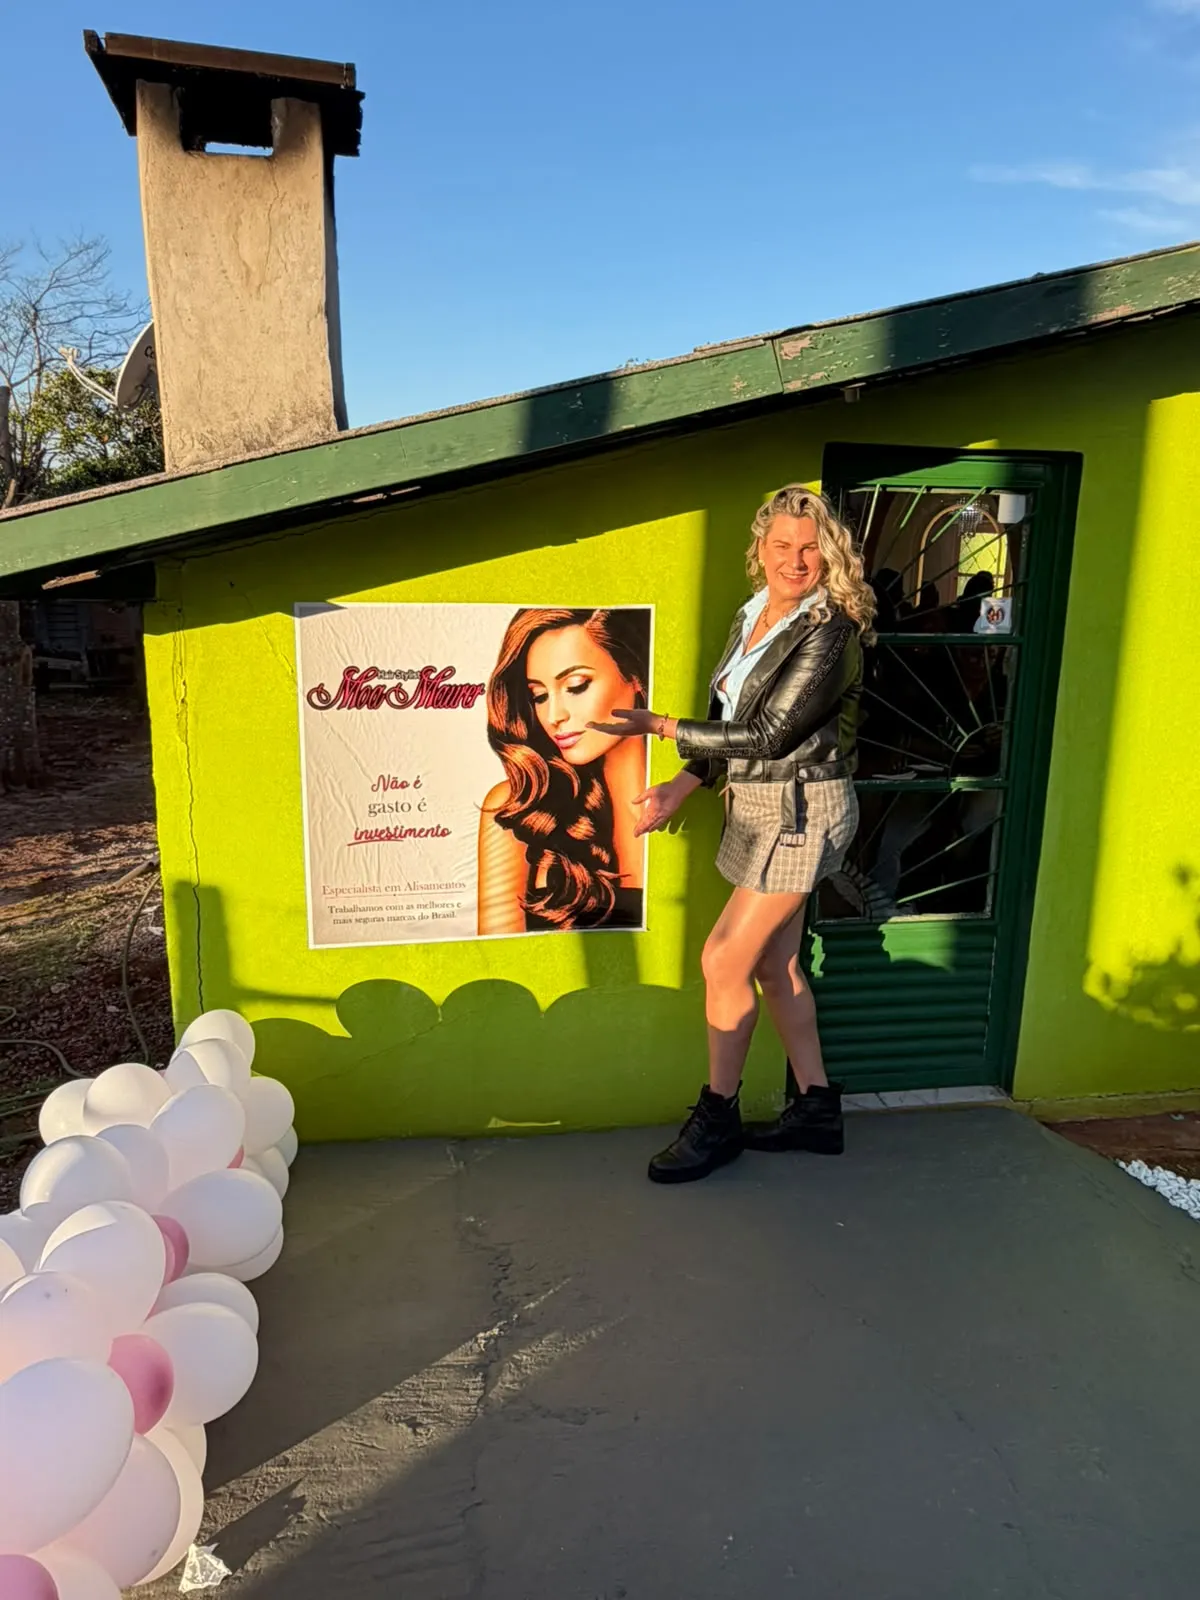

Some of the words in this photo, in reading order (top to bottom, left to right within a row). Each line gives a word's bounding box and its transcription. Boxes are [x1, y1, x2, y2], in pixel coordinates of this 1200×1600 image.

[371, 774, 410, 792] Não
[413, 775, 423, 789] é
[368, 801, 412, 818] gasto
[417, 798, 427, 813] é
[353, 824, 452, 841] investimento
[322, 884, 381, 897] Especialista
[384, 884, 401, 893] em
[404, 881, 466, 892] Alisamentos
[328, 905, 383, 915] Trabalhamos
[416, 901, 455, 910] melhores
[333, 917, 353, 925] mais
[354, 916, 385, 924] seguras
[418, 912, 429, 920] do
